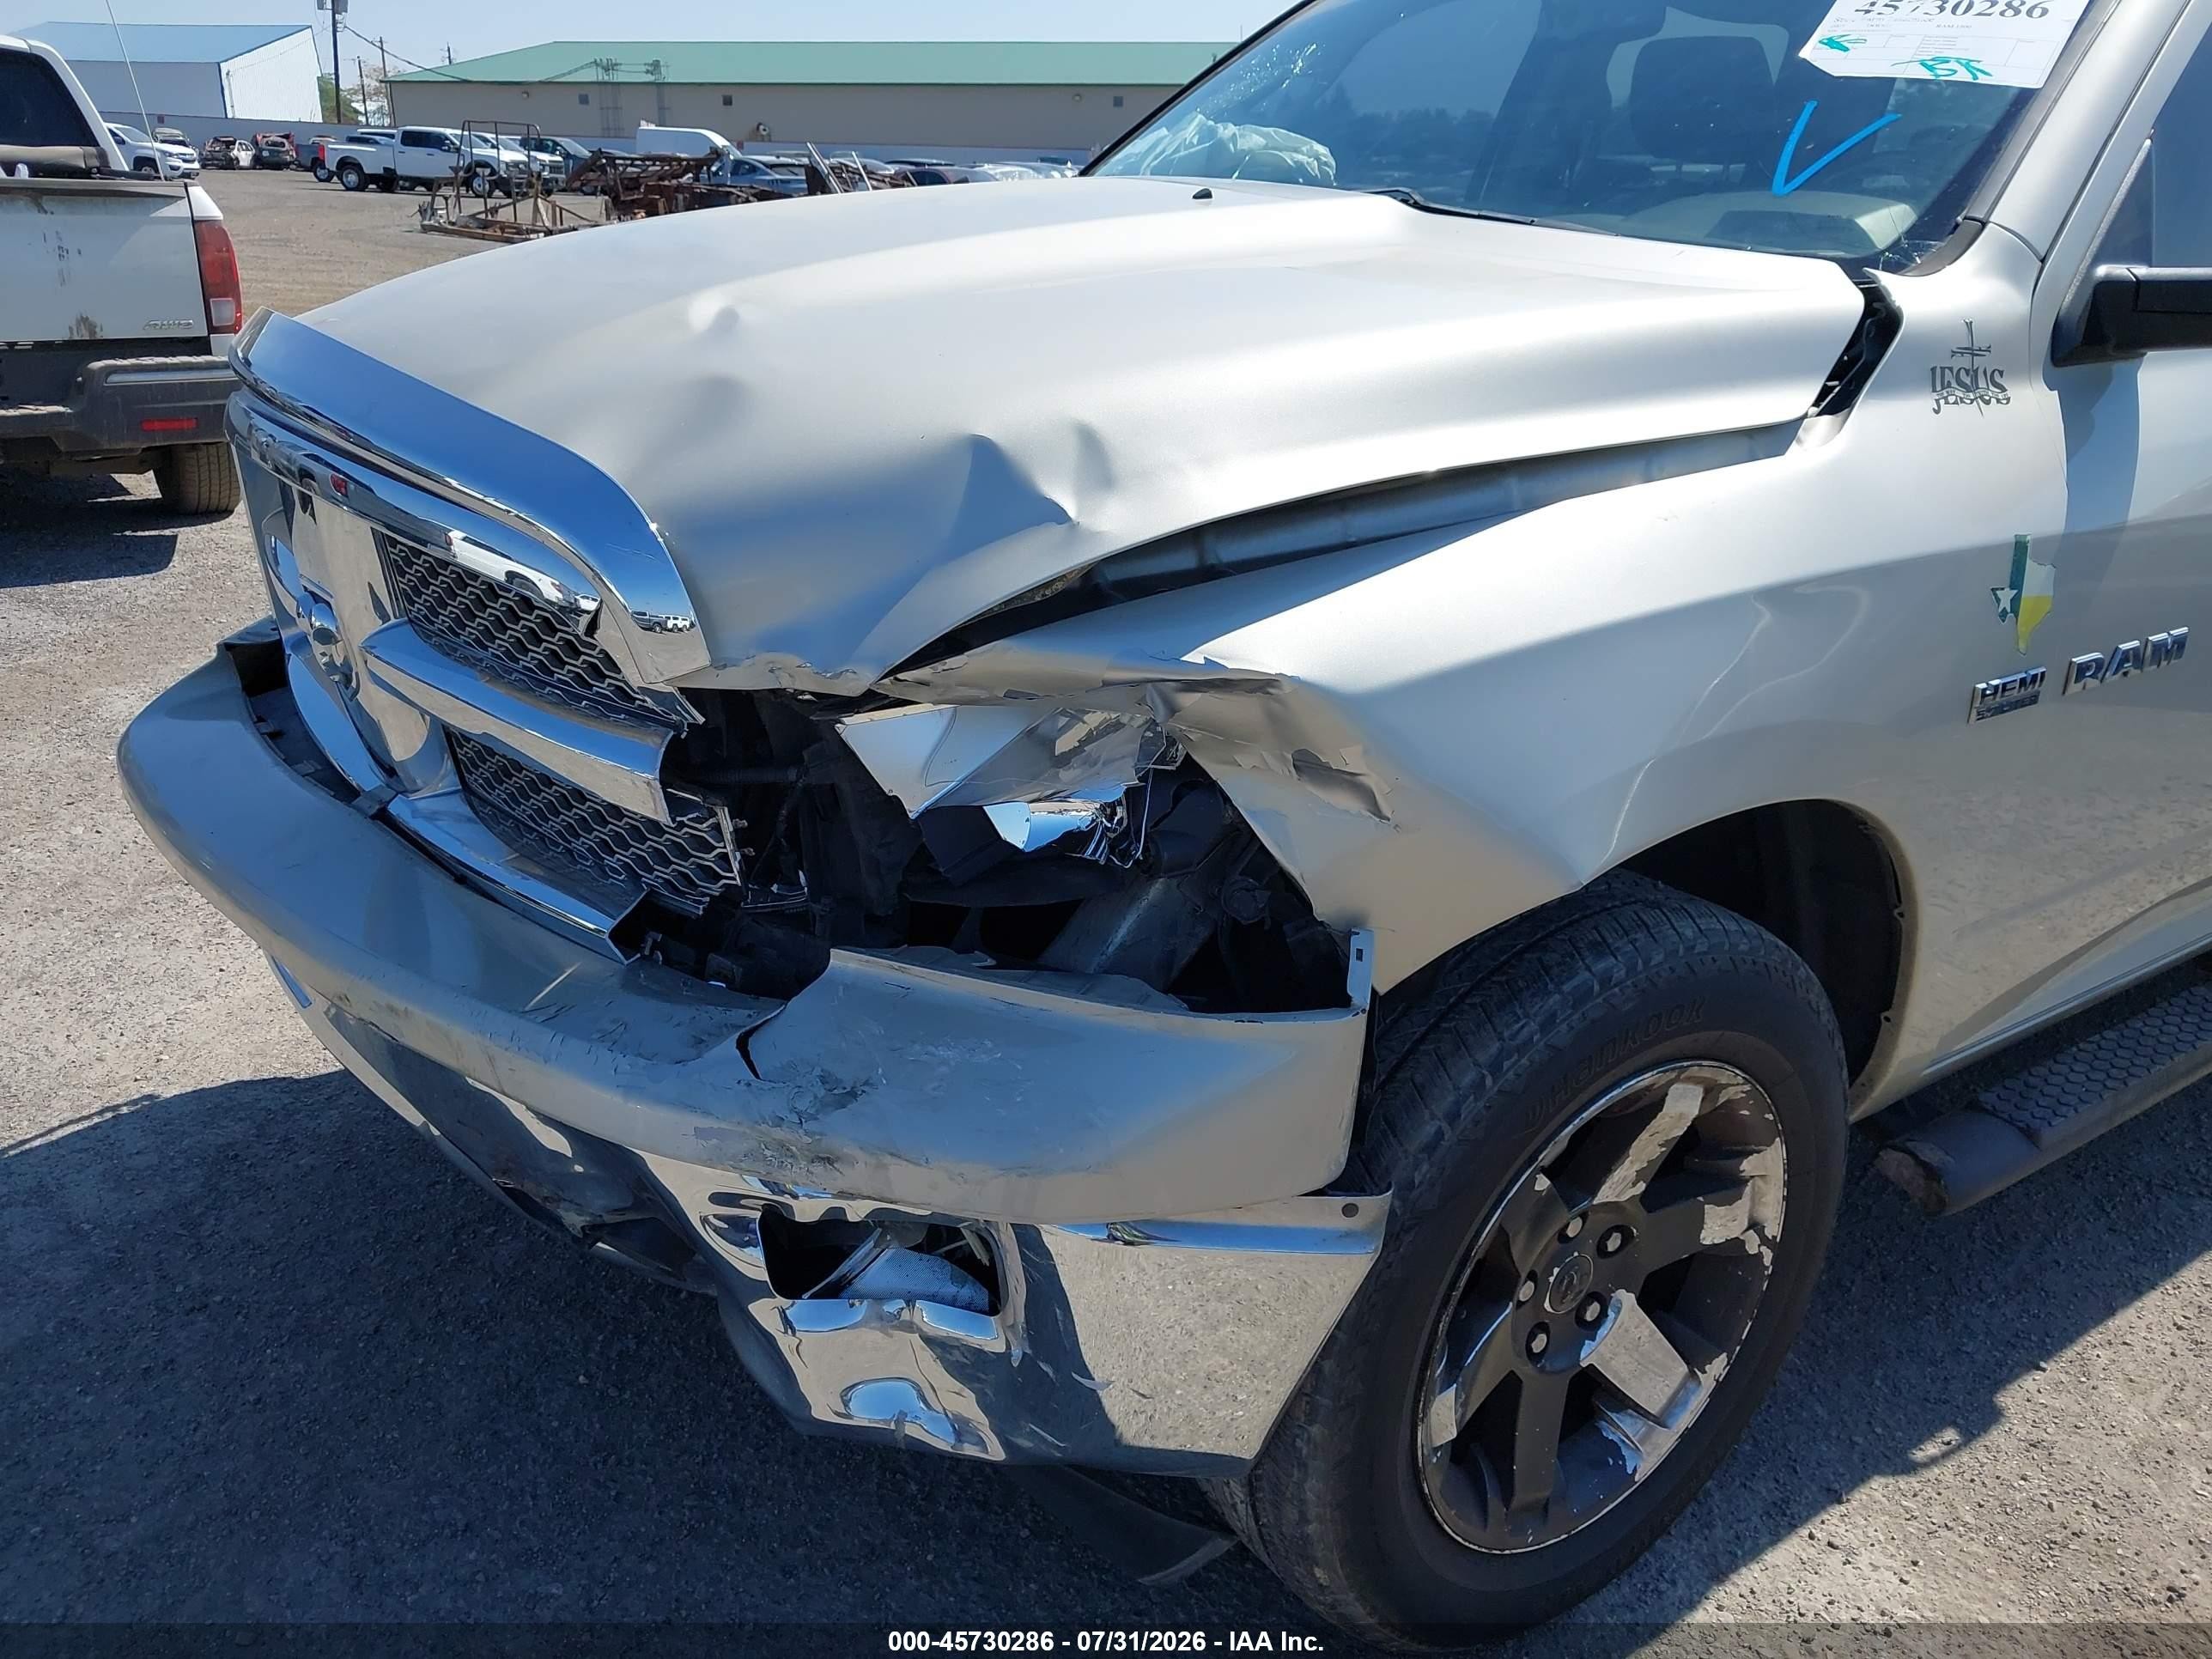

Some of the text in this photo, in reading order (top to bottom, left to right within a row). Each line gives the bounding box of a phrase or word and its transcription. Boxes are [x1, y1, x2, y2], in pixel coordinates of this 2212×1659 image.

[1929, 365, 2012, 416] JESUS
[1972, 665, 2047, 708] HEMI
[2062, 626, 2189, 696] RAM
